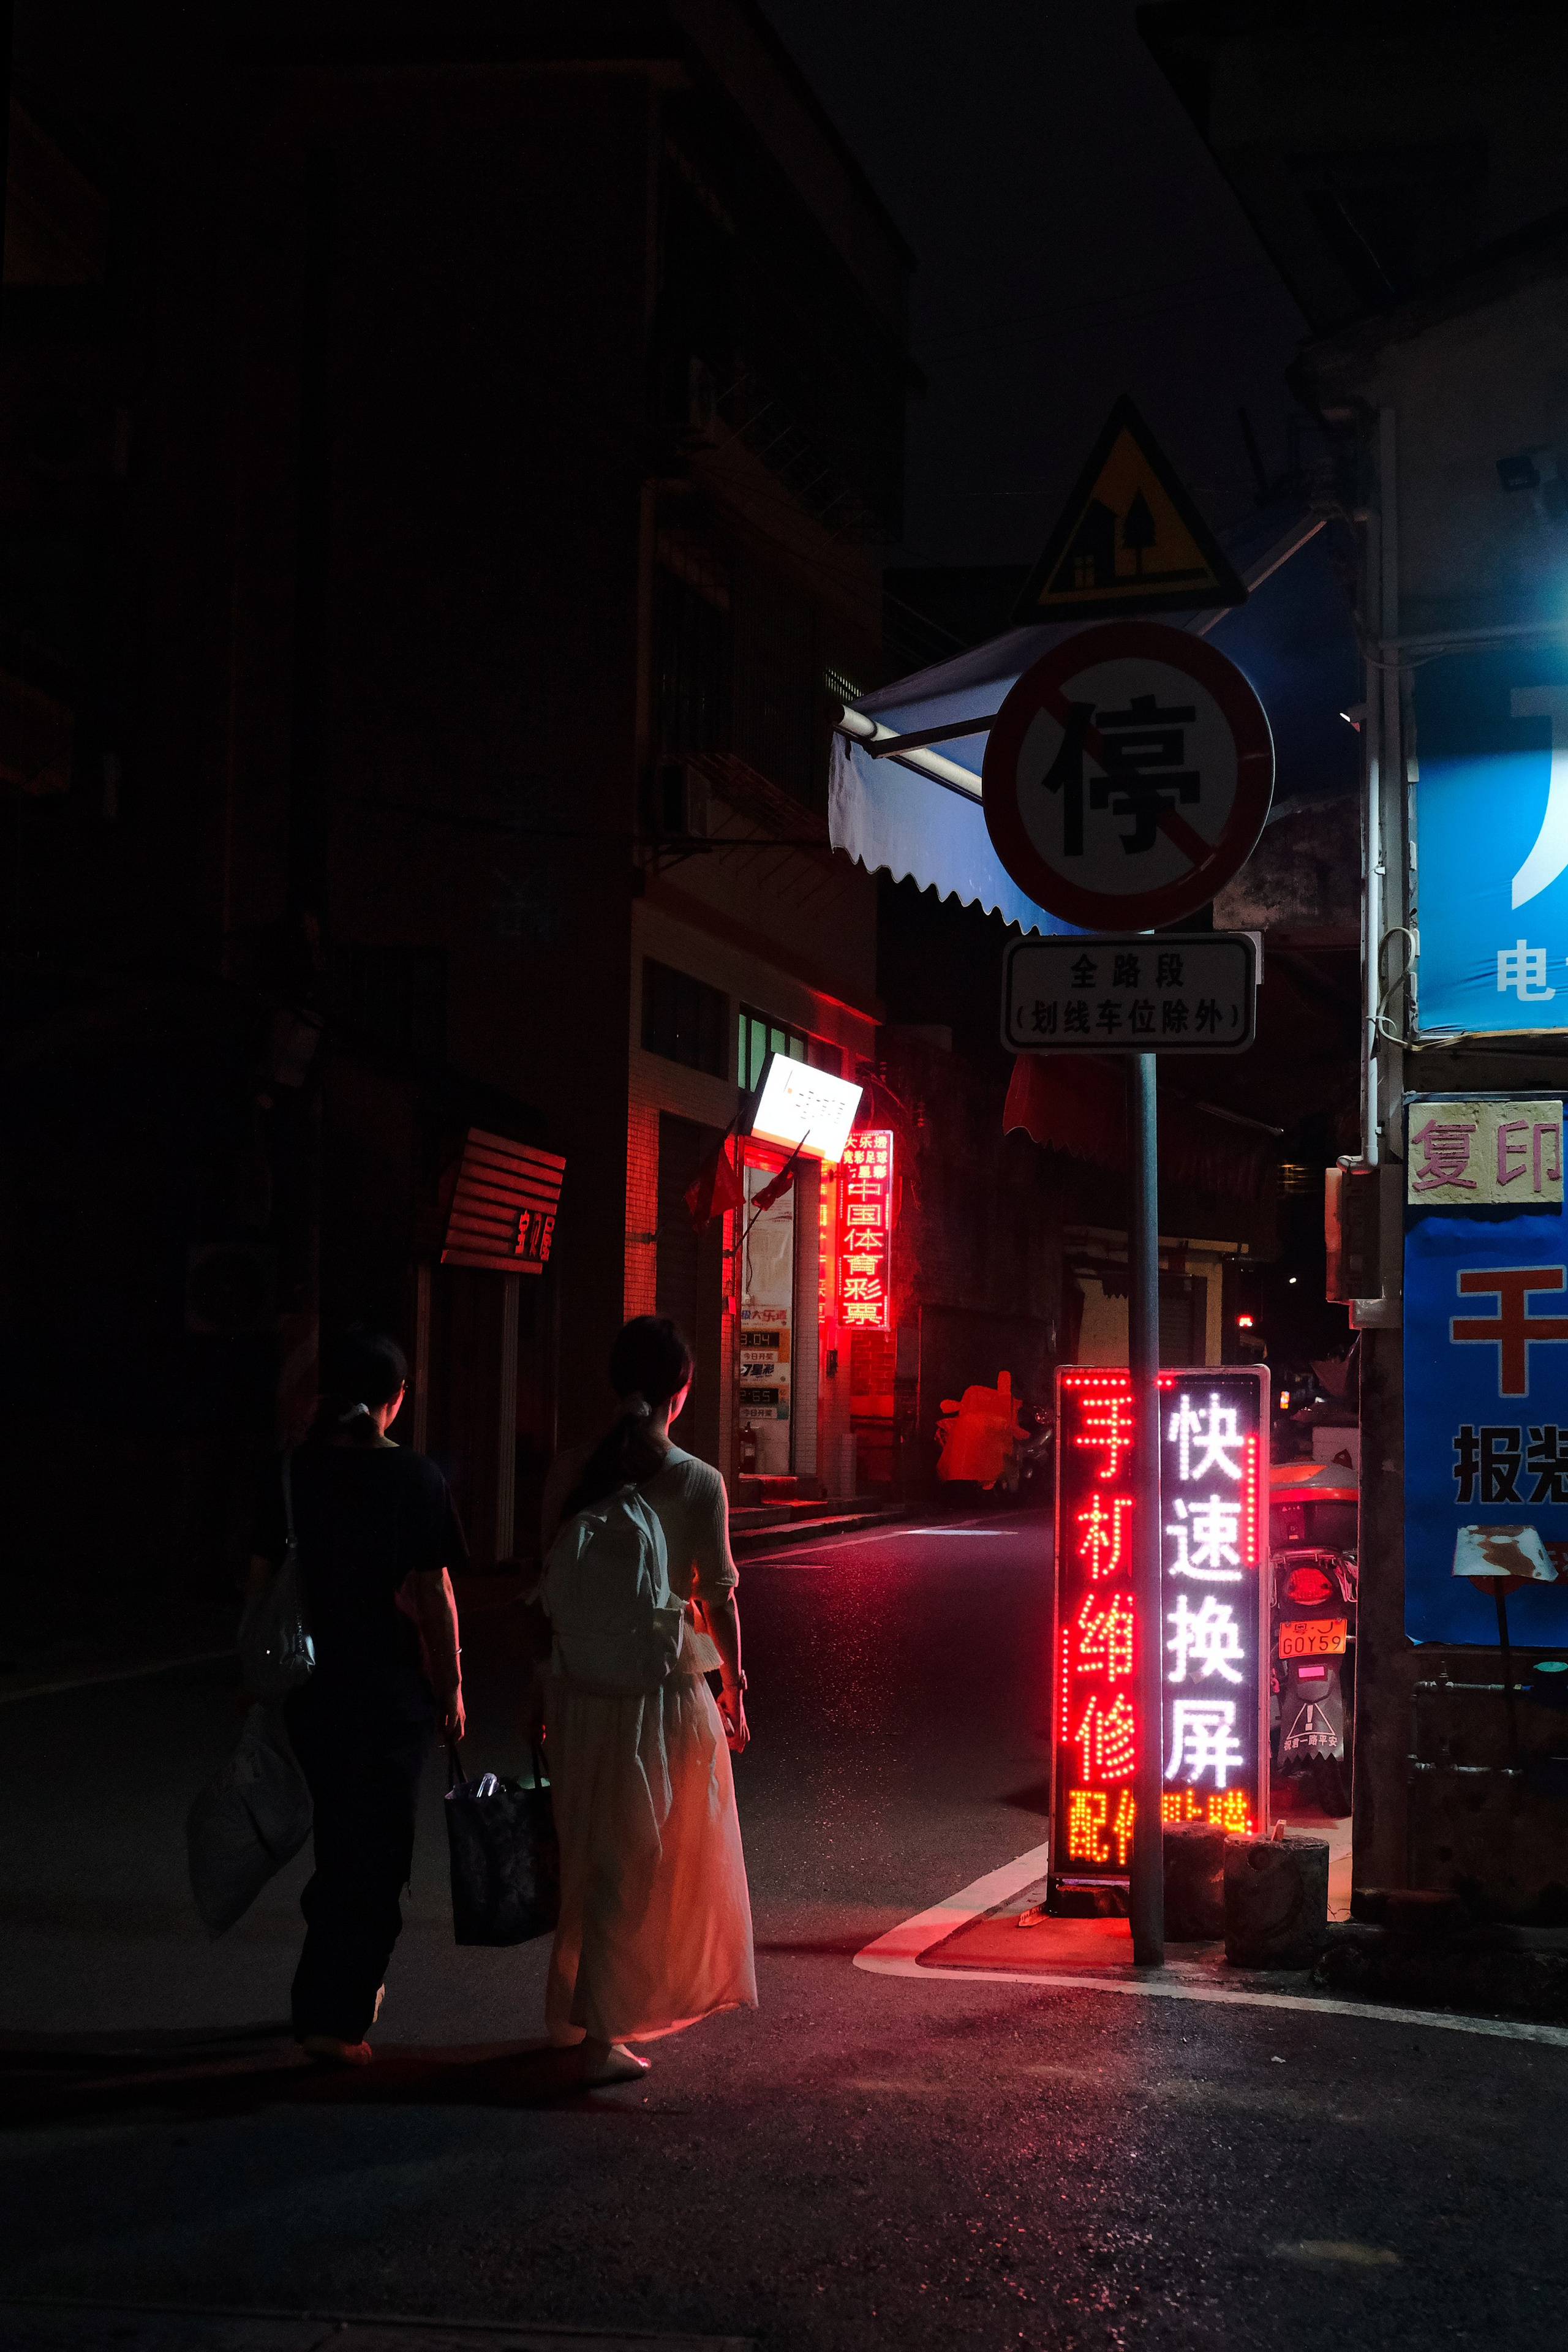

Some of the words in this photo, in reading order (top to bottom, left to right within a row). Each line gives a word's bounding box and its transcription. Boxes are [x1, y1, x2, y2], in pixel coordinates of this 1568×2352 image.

[1042, 694, 1200, 856] 停
[1070, 953, 1184, 989] 全路段
[1497, 939, 1568, 1002] 电
[1412, 1119, 1561, 1192] 复印
[843, 1179, 883, 1325] 中国体育彩票
[1073, 1394, 1136, 1782] 手机维修
[1165, 1392, 1246, 1788] 快速换屏
[1284, 1734, 1338, 1751] 祝君一路平安
